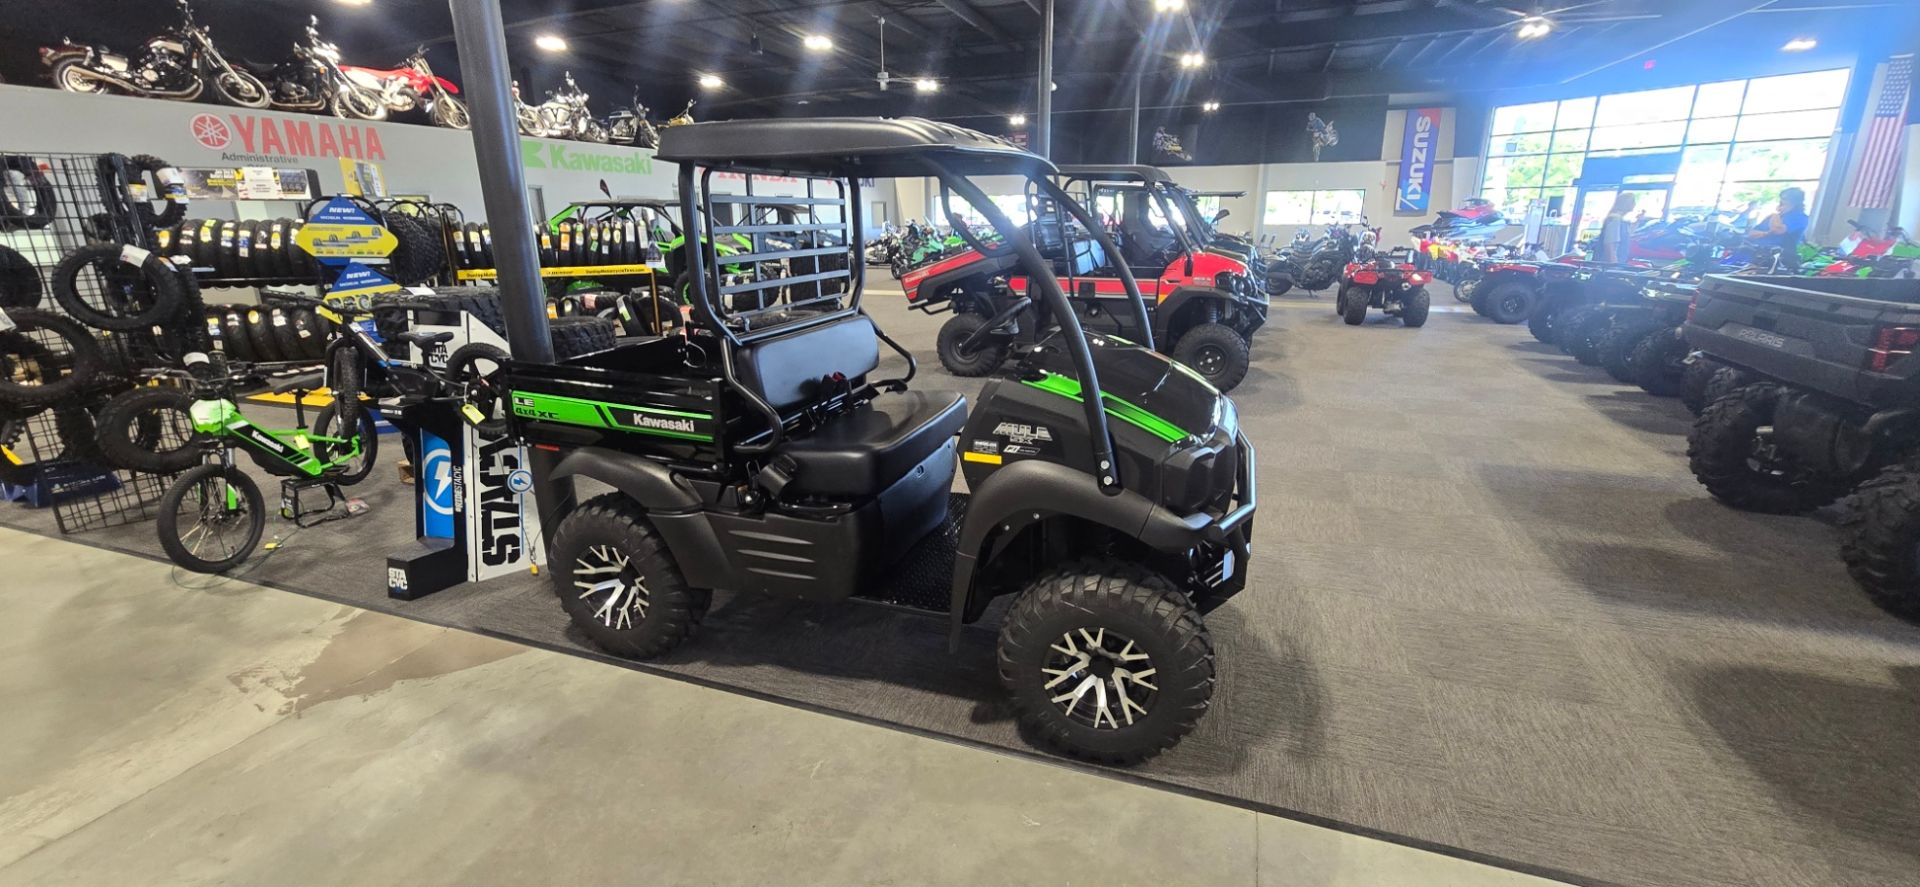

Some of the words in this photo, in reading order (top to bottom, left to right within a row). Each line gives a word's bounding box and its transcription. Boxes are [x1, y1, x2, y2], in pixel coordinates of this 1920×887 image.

[229, 114, 386, 160] YAMAHA
[222, 152, 299, 164] Administrative
[550, 143, 652, 175] Kawasaki
[1406, 116, 1432, 200] SUZUKI
[513, 396, 535, 406] LE
[633, 413, 695, 432] Kawasaki
[992, 422, 1053, 441] MULE
[388, 567, 407, 578] STA
[388, 578, 408, 591] CYC
